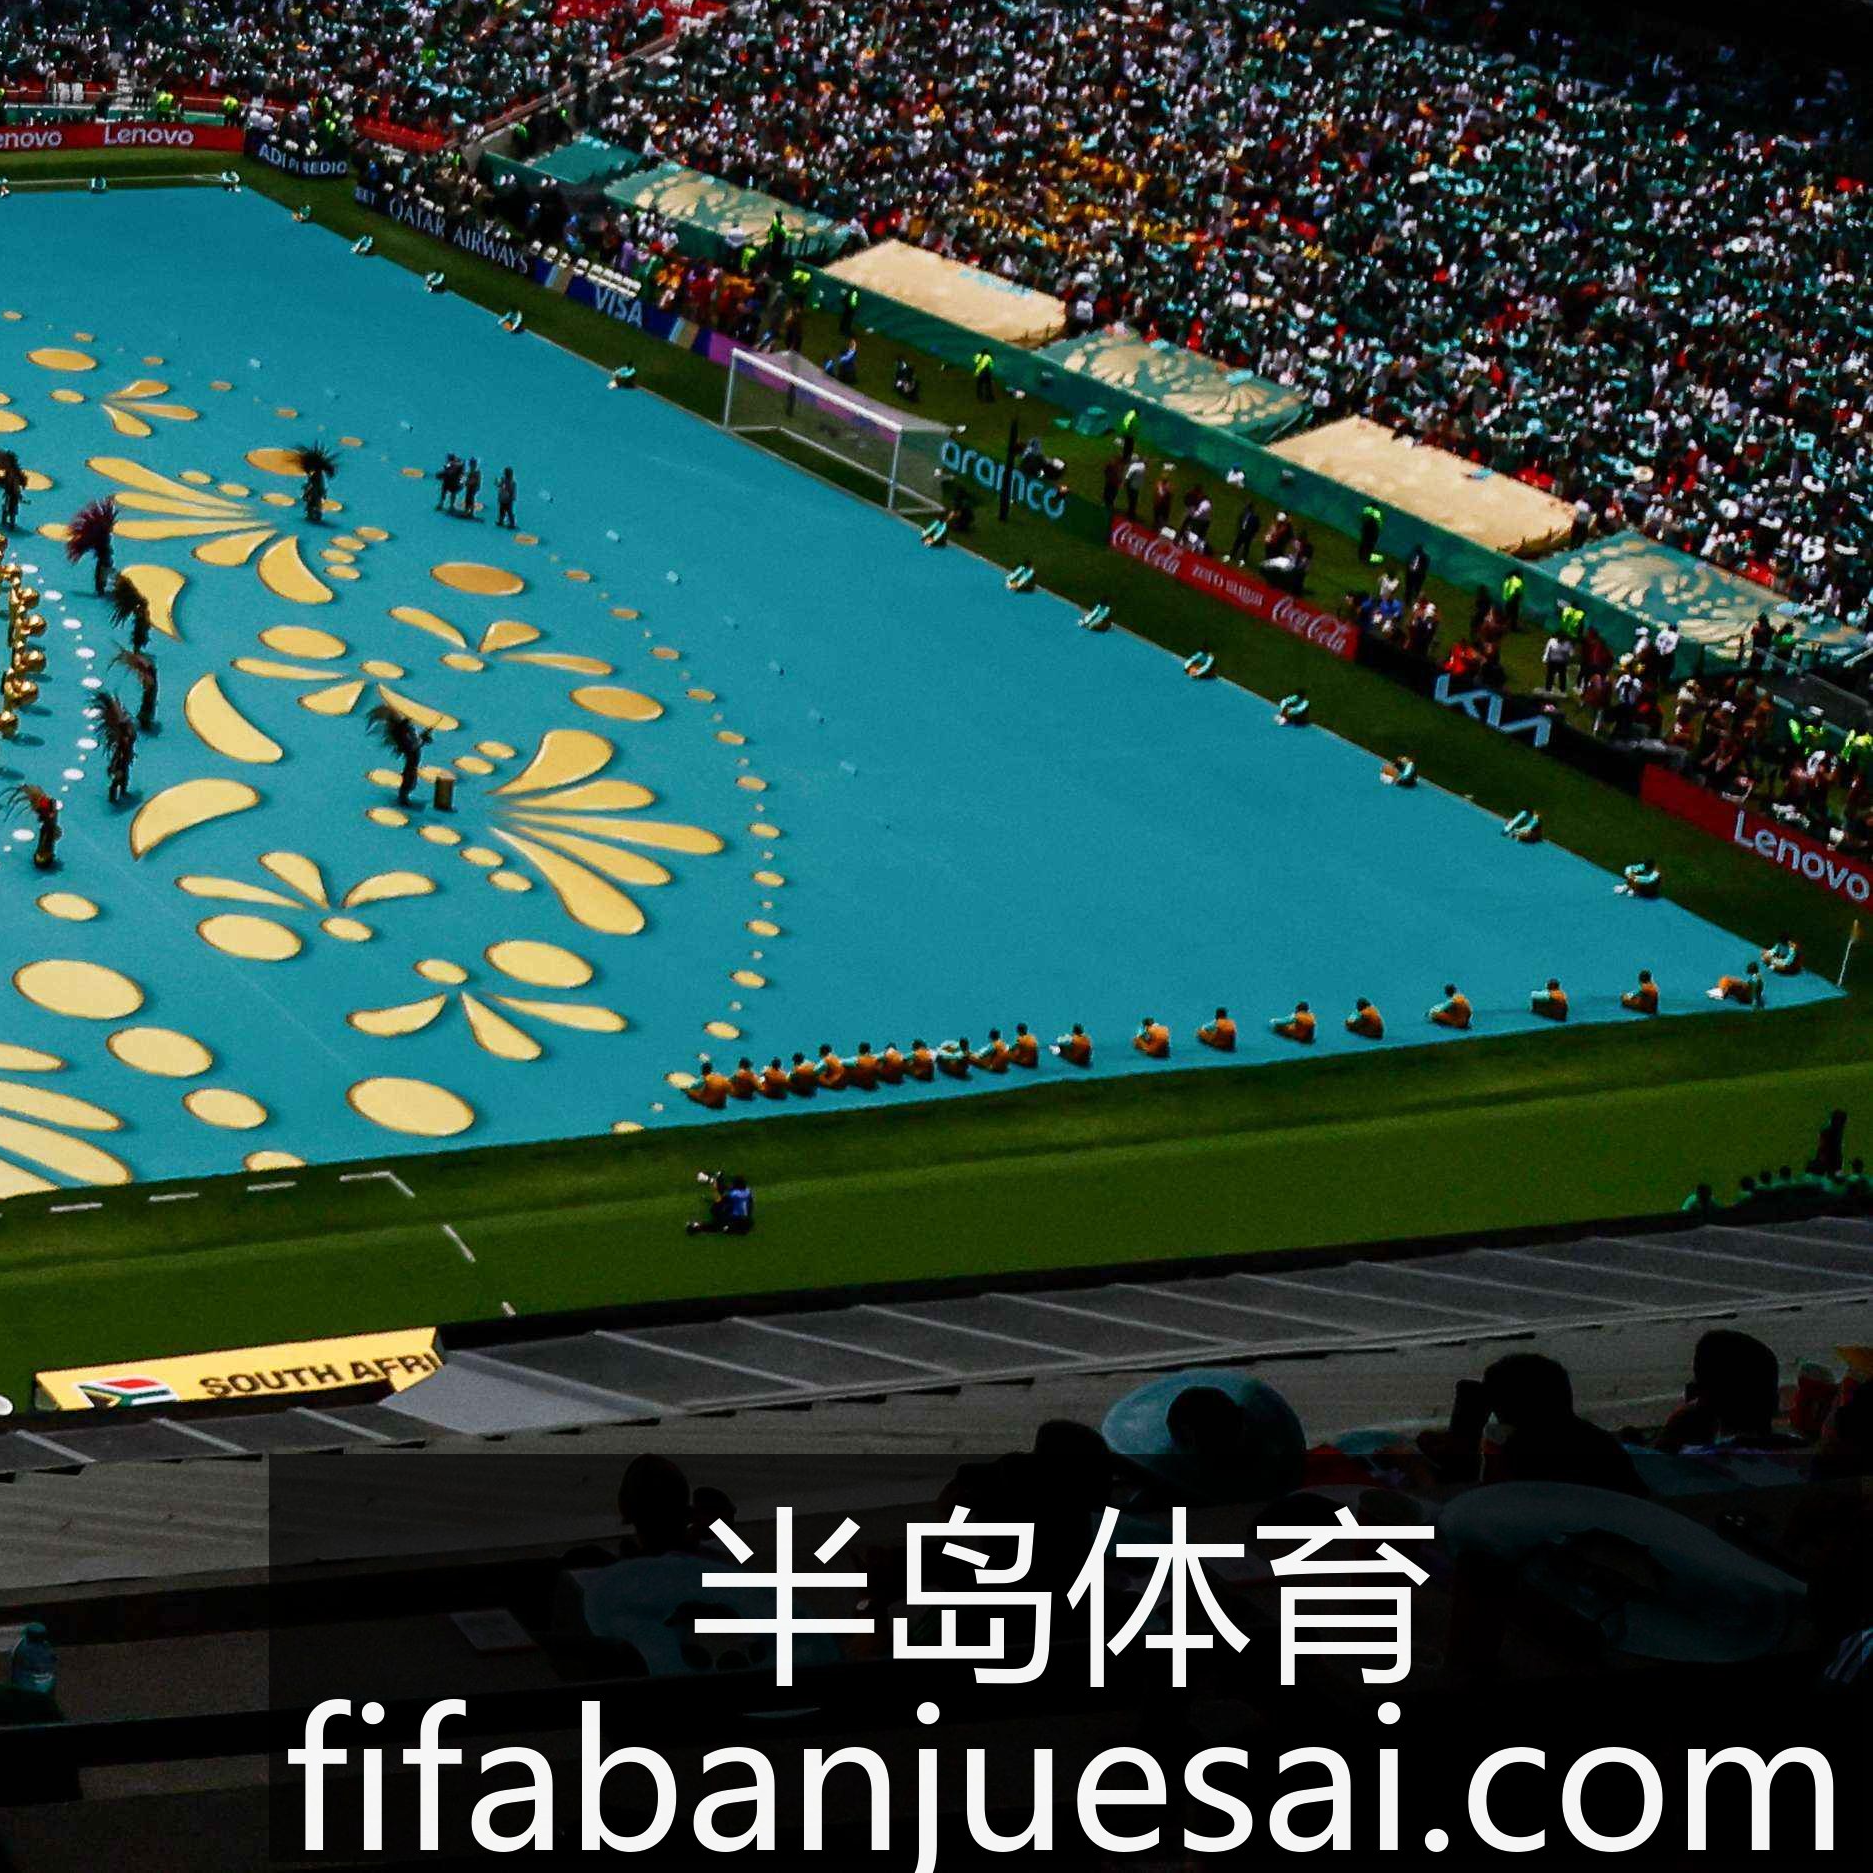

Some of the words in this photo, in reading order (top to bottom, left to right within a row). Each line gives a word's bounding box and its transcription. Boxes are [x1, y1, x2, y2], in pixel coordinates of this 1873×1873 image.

[102, 124, 195, 147] Lenovo
[388, 196, 446, 237] QATAR
[453, 223, 529, 275] AIRWAYS
[593, 284, 645, 327] VISA
[939, 439, 1068, 520] aramco
[1432, 673, 1553, 749] KIA
[1733, 809, 1872, 903] Lenovo
[198, 1362, 342, 1399] SOUTH
